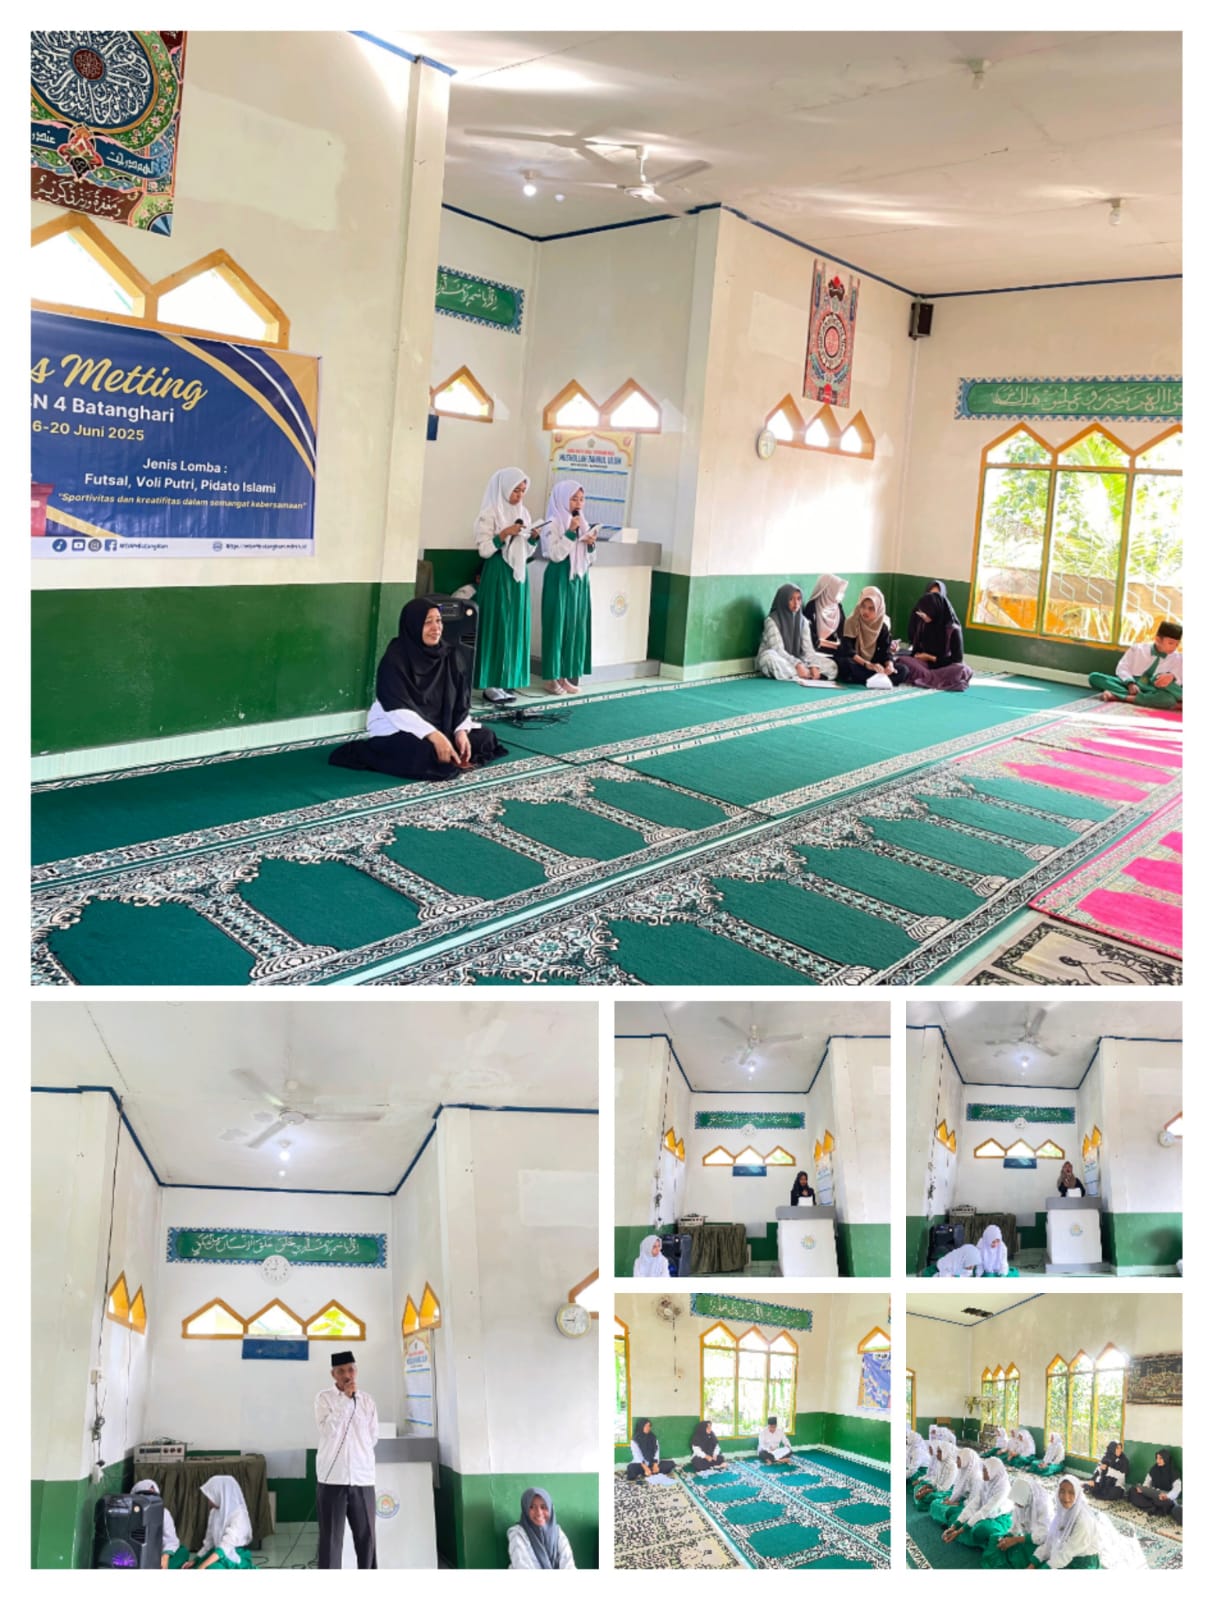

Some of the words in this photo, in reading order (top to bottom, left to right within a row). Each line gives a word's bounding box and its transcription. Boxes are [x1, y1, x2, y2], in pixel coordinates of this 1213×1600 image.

[61, 354, 208, 411] Metting
[54, 396, 66, 412] 4
[72, 398, 174, 423] Batanghari
[74, 424, 105, 438] Juni
[108, 427, 144, 441] 2025
[143, 458, 177, 471] Jenis
[180, 460, 220, 474] Lomba
[84, 473, 132, 488] Futsal,
[136, 476, 161, 488] Voli
[164, 478, 197, 493] Putri,
[200, 480, 240, 492] Pidato
[243, 480, 276, 494] Islami
[58, 492, 115, 505] "Sportivitas
[117, 495, 134, 504] dan
[136, 496, 181, 505] kreatifitas
[183, 498, 208, 506] dalam
[210, 500, 250, 509] semangat
